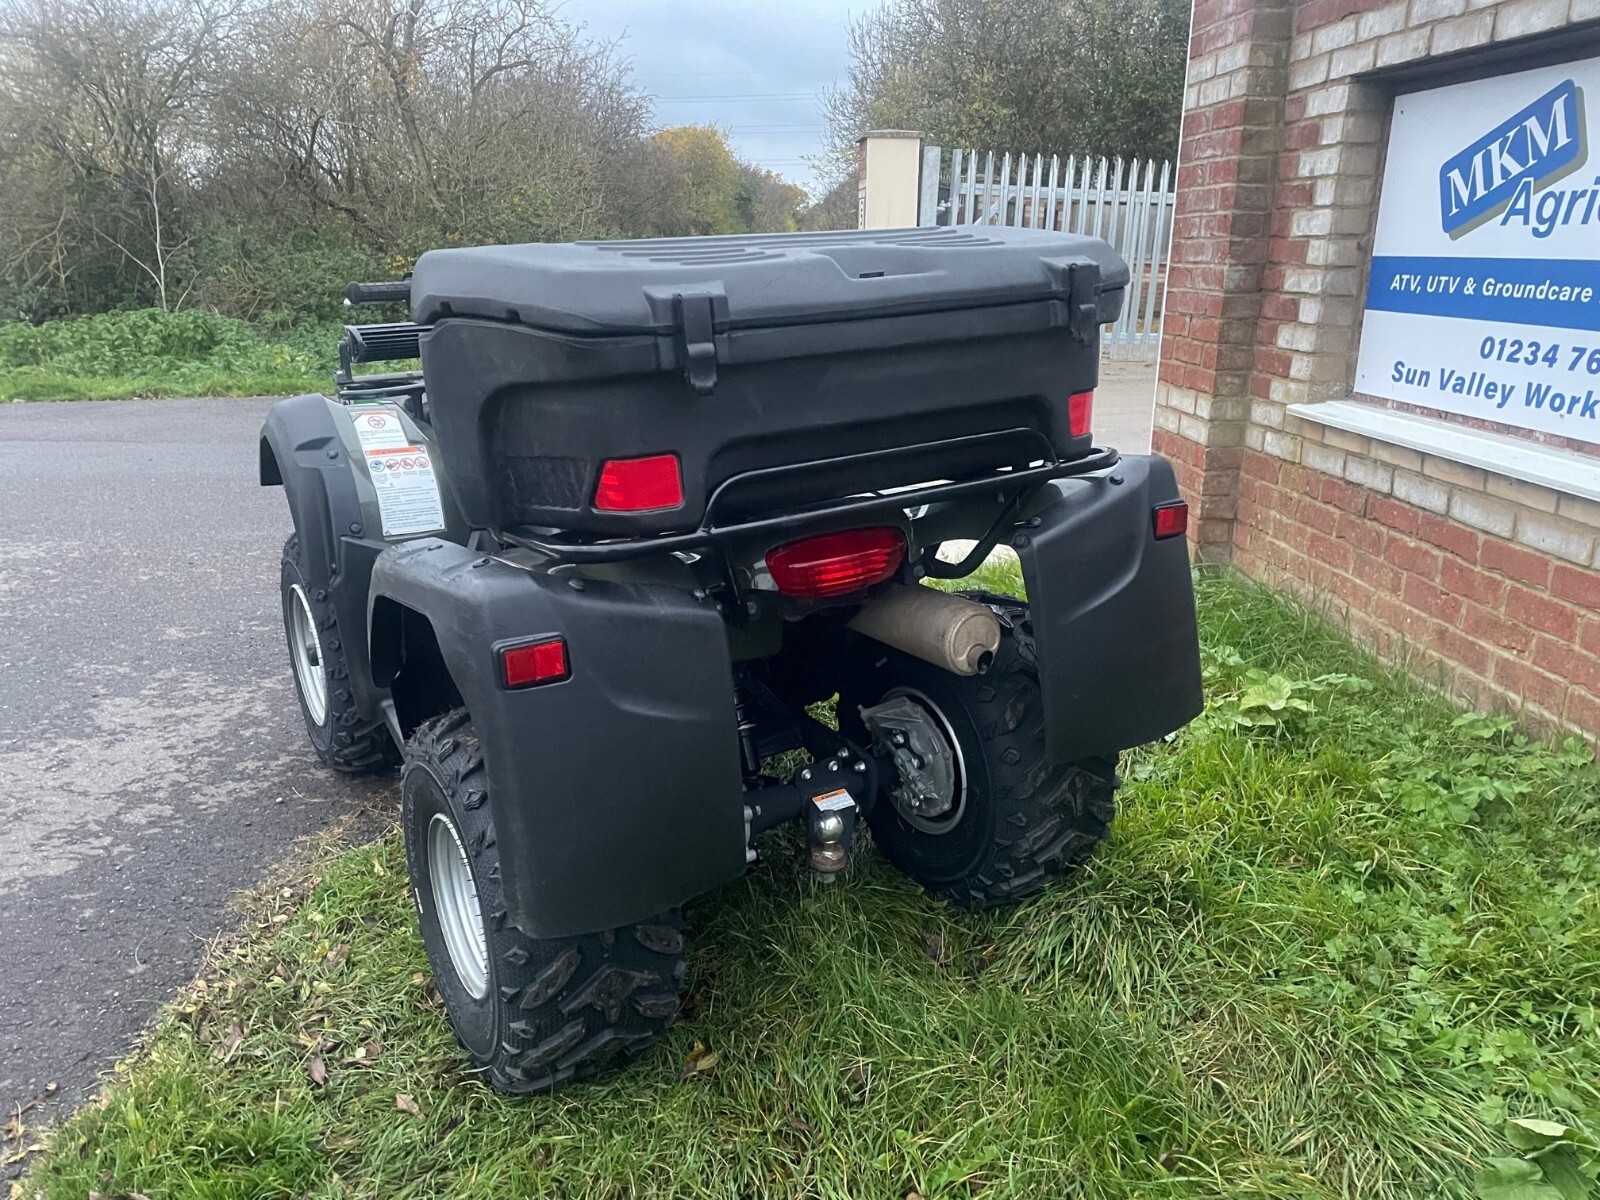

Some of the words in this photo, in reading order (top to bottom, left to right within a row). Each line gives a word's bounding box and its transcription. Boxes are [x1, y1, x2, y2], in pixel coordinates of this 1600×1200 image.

[1446, 92, 1573, 217] MKM
[1499, 175, 1600, 238] Agri
[1390, 274, 1422, 294] ATV,
[1426, 275, 1460, 294] UTV
[1463, 276, 1477, 295] &
[1482, 277, 1593, 303] Groundcare
[1480, 336, 1560, 368] 01234
[1567, 346, 1600, 375] 76
[1391, 360, 1431, 388] Sun
[1439, 368, 1515, 409] Valley
